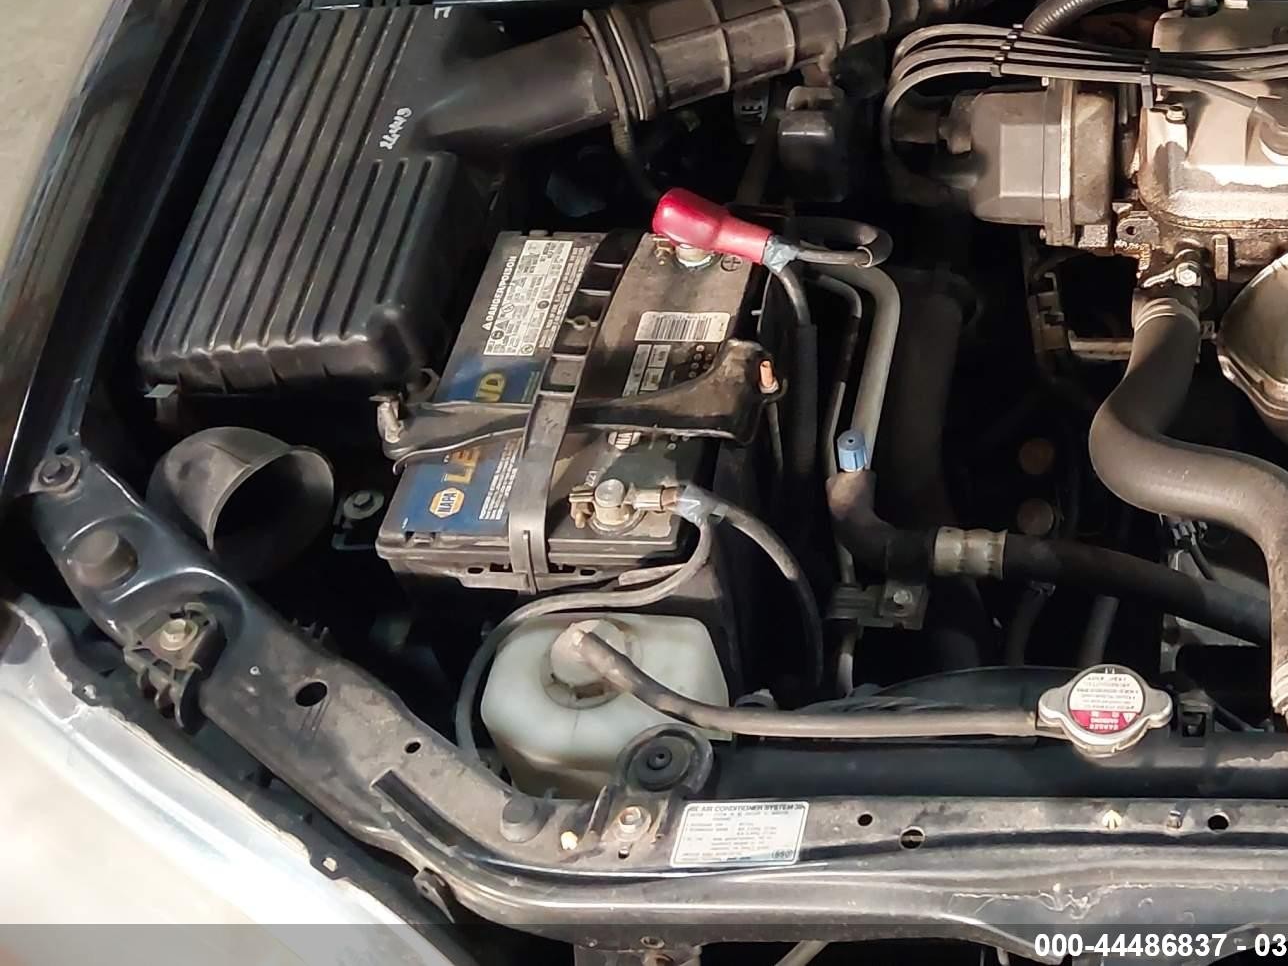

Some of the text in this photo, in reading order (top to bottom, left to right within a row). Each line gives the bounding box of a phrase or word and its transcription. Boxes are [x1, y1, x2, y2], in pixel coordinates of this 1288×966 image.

[437, 491, 458, 514] NAPA
[715, 804, 763, 812] CONDITIONER
[763, 803, 794, 811] SYSTEM
